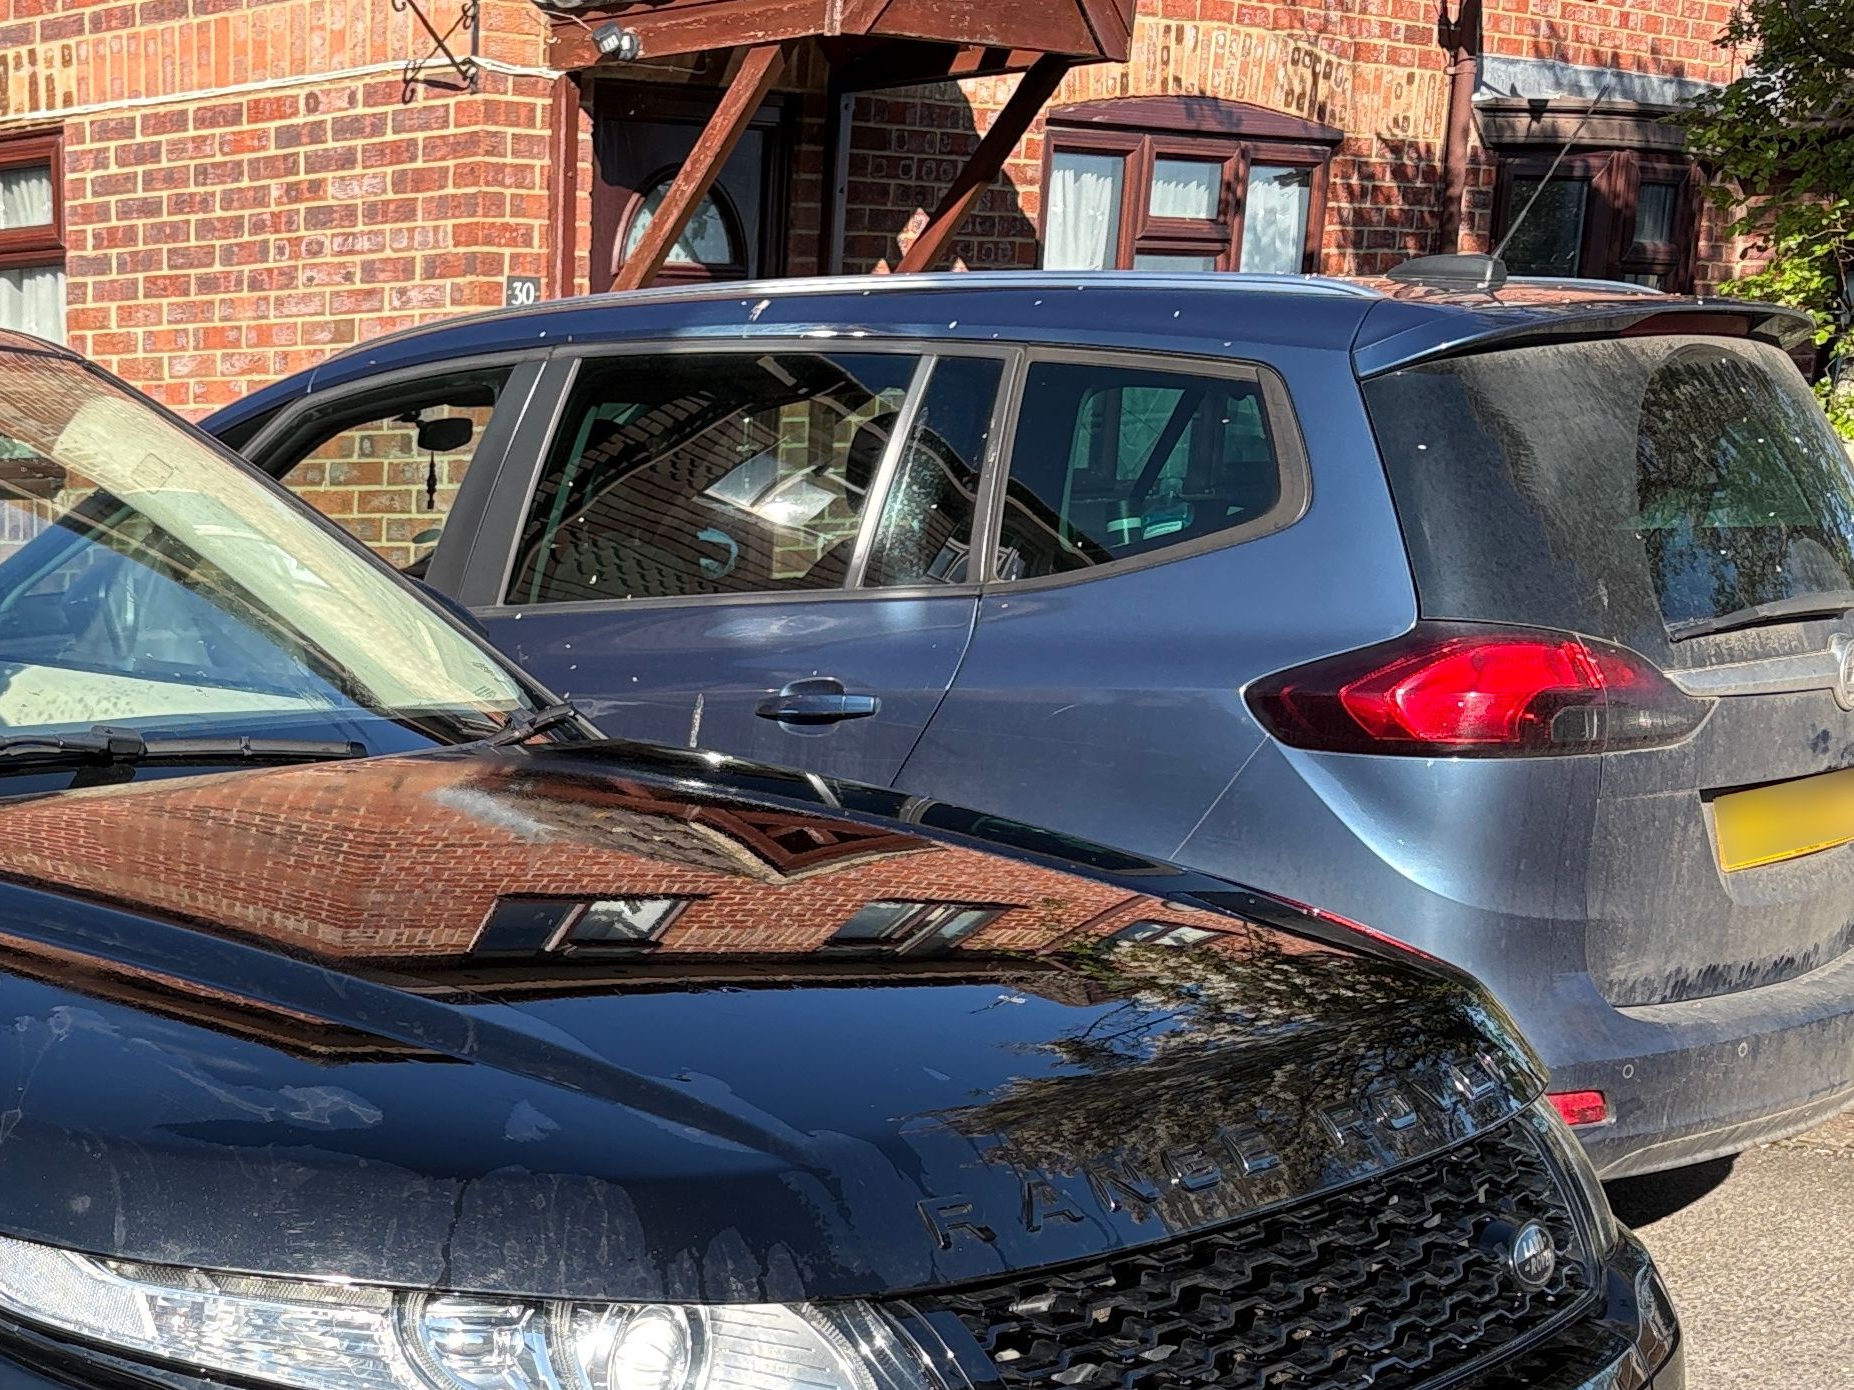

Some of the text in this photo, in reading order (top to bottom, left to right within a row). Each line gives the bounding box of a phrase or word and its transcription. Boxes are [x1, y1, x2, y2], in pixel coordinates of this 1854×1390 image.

[511, 281, 535, 305] 30
[915, 1046, 1517, 1250] RANGE ROVER
